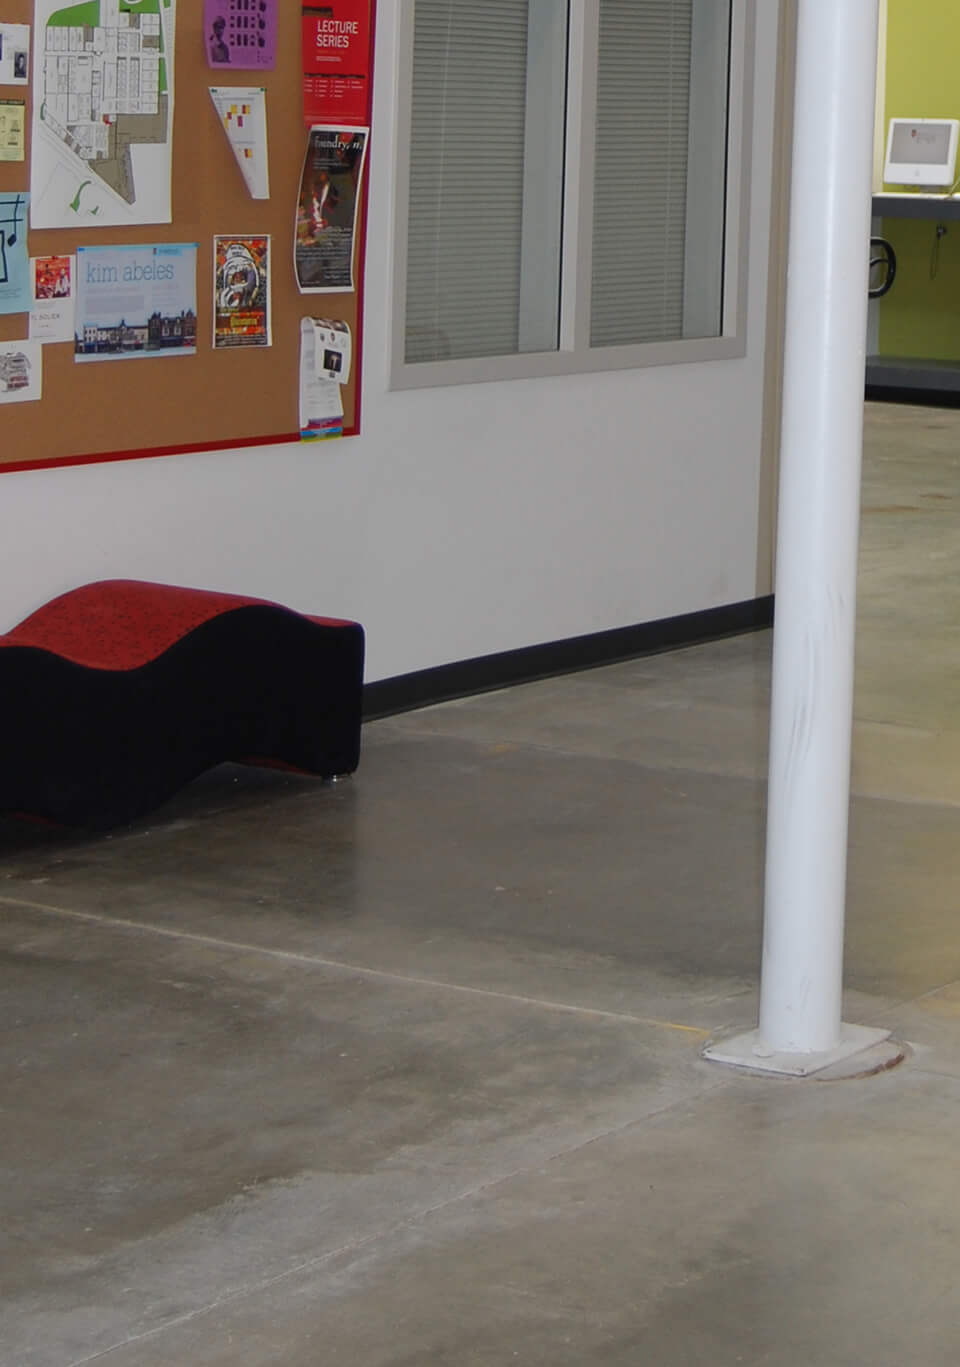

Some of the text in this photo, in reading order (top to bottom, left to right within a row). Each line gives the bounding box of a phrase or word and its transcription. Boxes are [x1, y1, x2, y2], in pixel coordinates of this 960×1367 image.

[317, 19, 359, 34] LECTURE
[316, 34, 349, 48] SERIES
[86, 260, 175, 284] kim abeles
